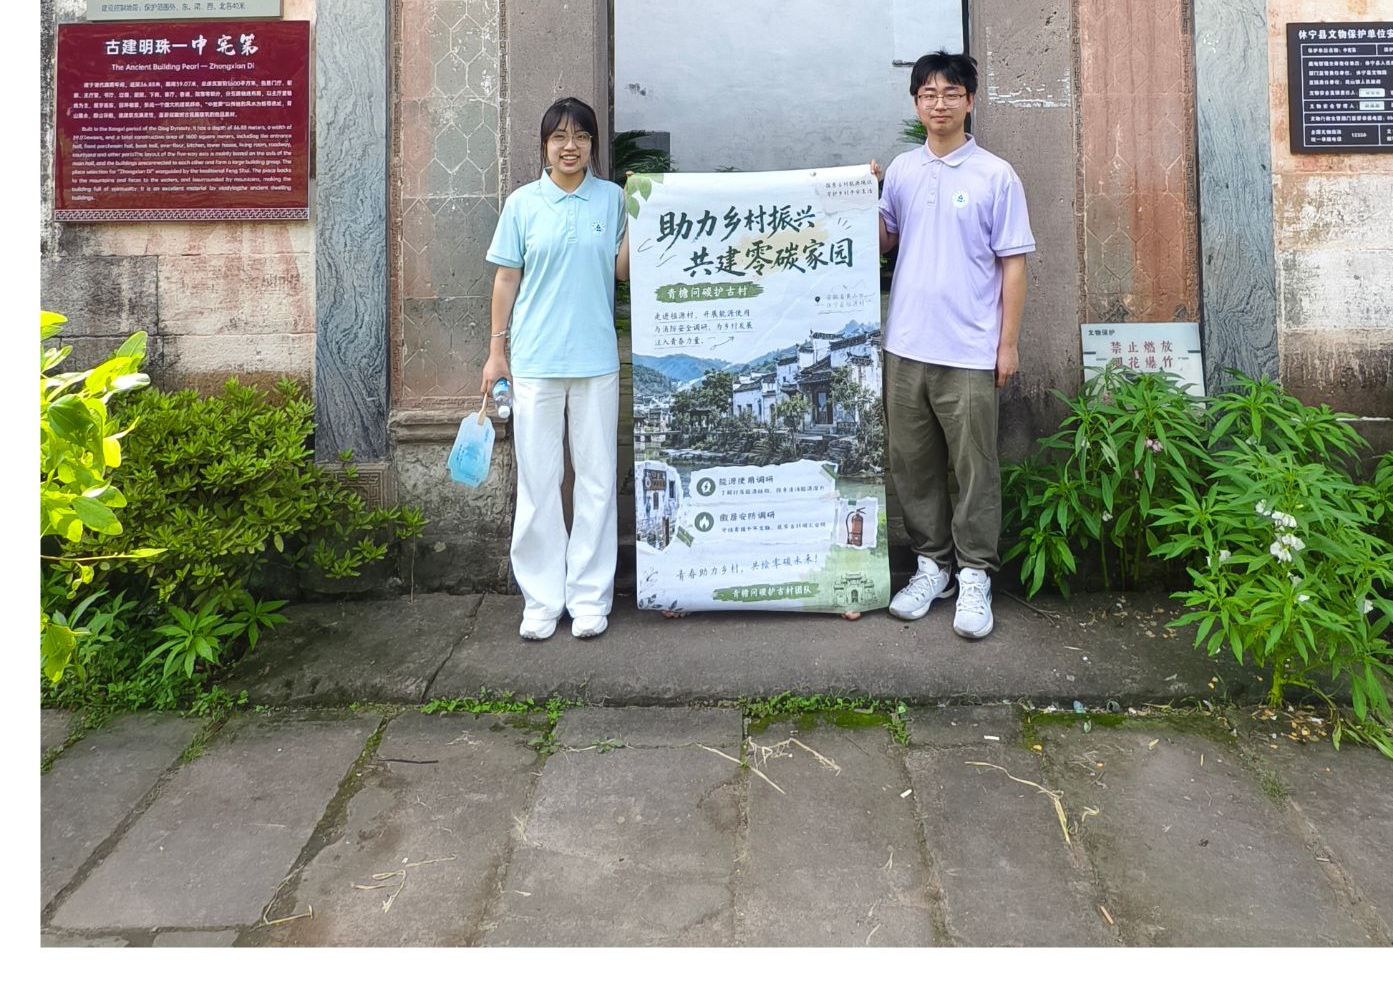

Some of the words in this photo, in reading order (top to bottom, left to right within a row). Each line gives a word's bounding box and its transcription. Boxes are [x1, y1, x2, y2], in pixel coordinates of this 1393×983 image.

[152, 63, 180, 71] Building
[209, 62, 246, 71] Zhongxian
[656, 205, 816, 252] 助力乡村振兴
[683, 237, 853, 278] 共建零碳家园
[1110, 340, 1174, 355] 禁止燃放
